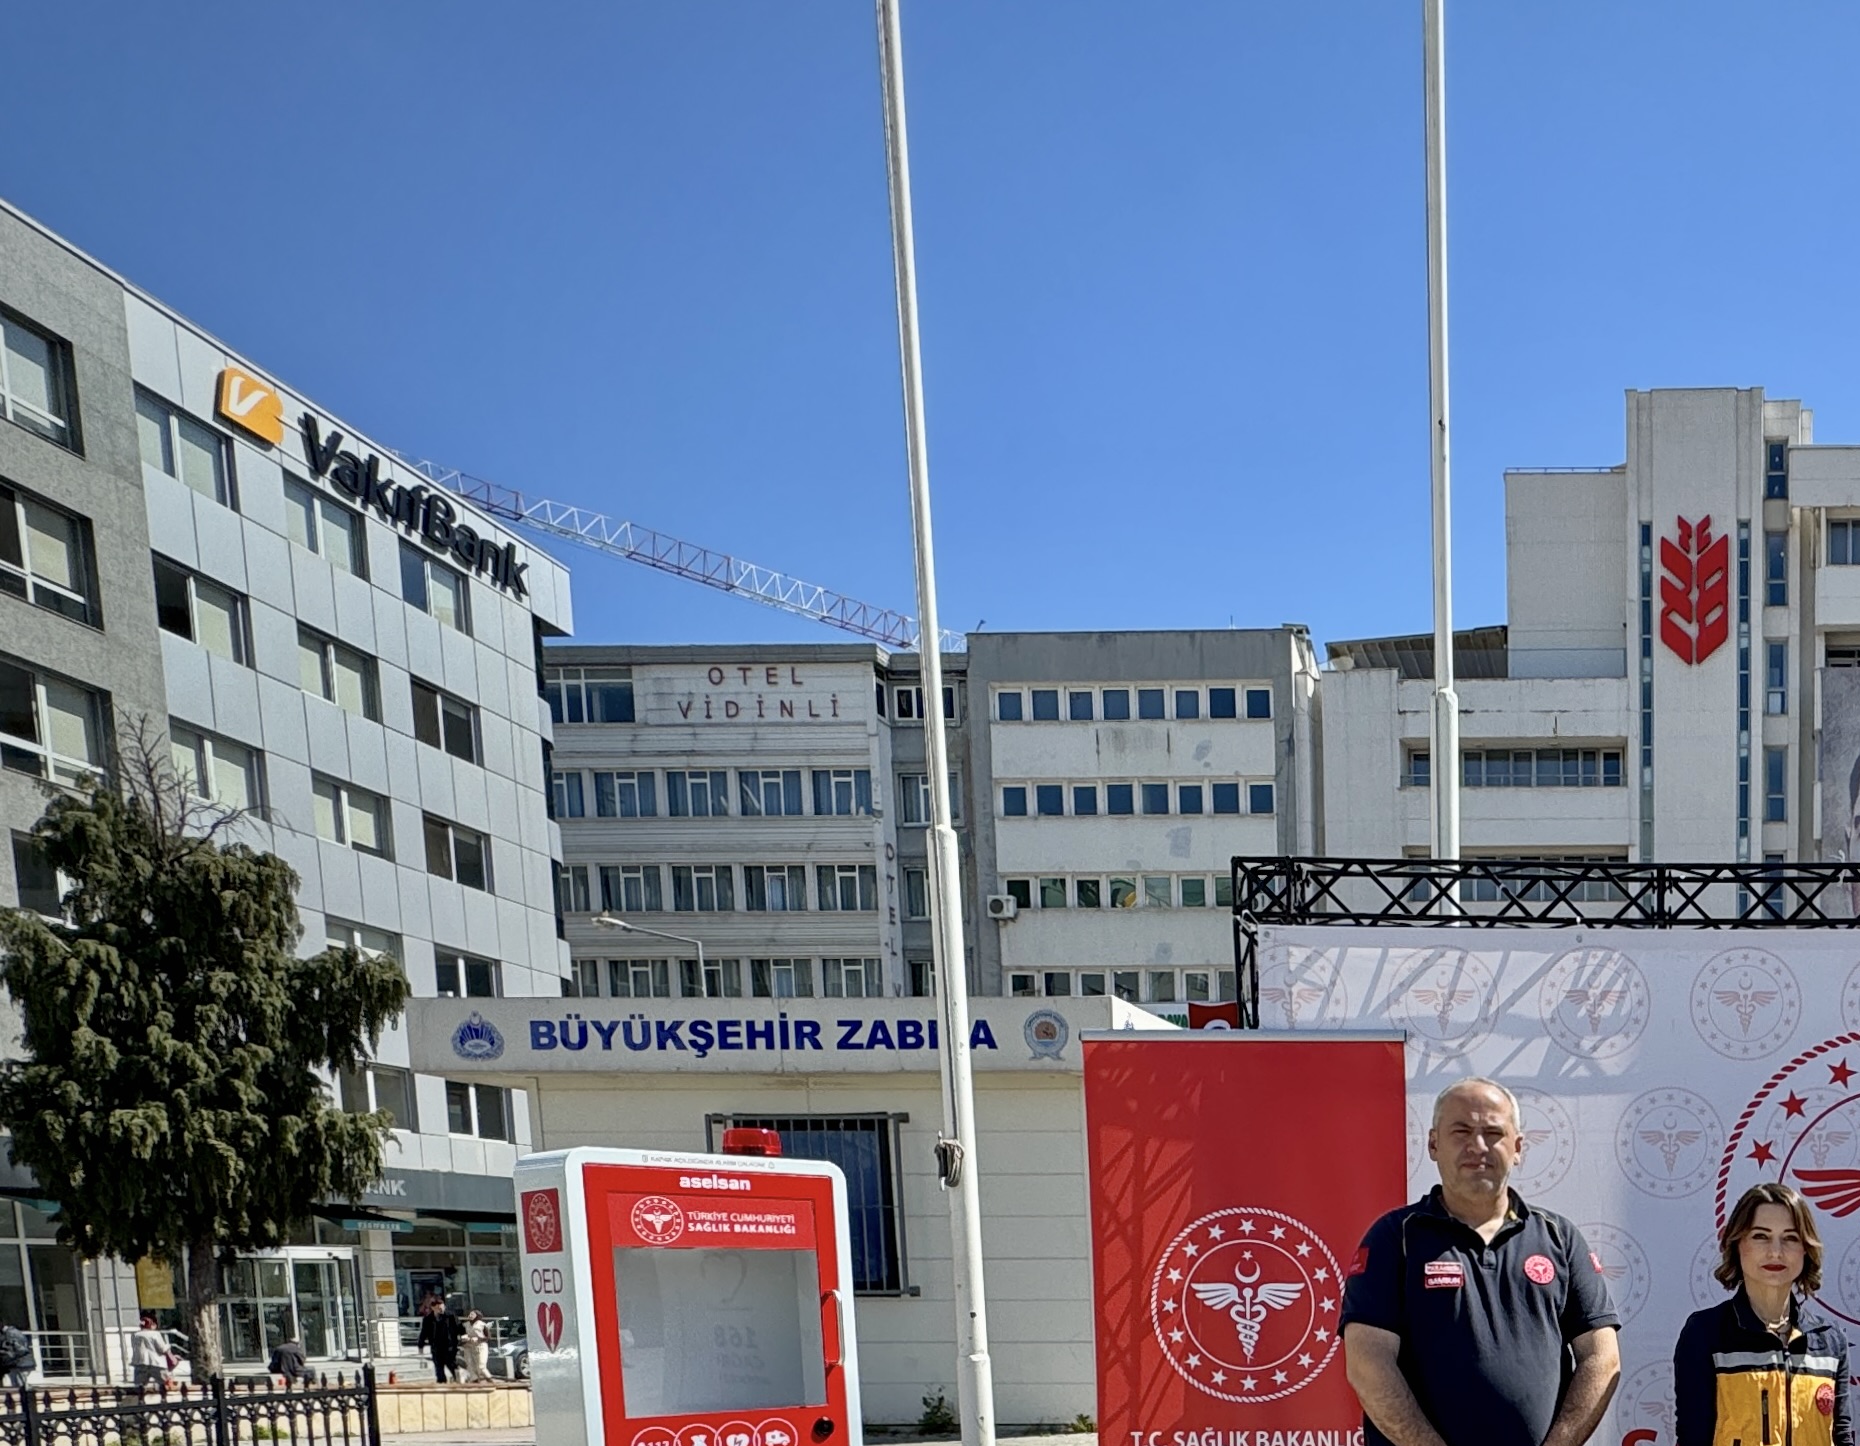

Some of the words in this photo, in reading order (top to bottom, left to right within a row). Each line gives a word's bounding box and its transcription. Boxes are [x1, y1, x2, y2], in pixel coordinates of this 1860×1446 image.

[299, 411, 529, 598] VakıfBank
[708, 666, 804, 686] OTEL
[677, 693, 839, 720] VİDİNLİ
[529, 1012, 822, 1059] BÜYÜKŞEHİR
[836, 1019, 998, 1051] ZABIA
[679, 1173, 751, 1191] aselsan
[686, 1210, 729, 1222] TÜRKİYE
[730, 1212, 795, 1224] CUMHURİYETİ
[688, 1222, 731, 1233] SAĞLIK
[734, 1223, 796, 1234] BAKANLIĞI
[531, 1268, 563, 1294] OED
